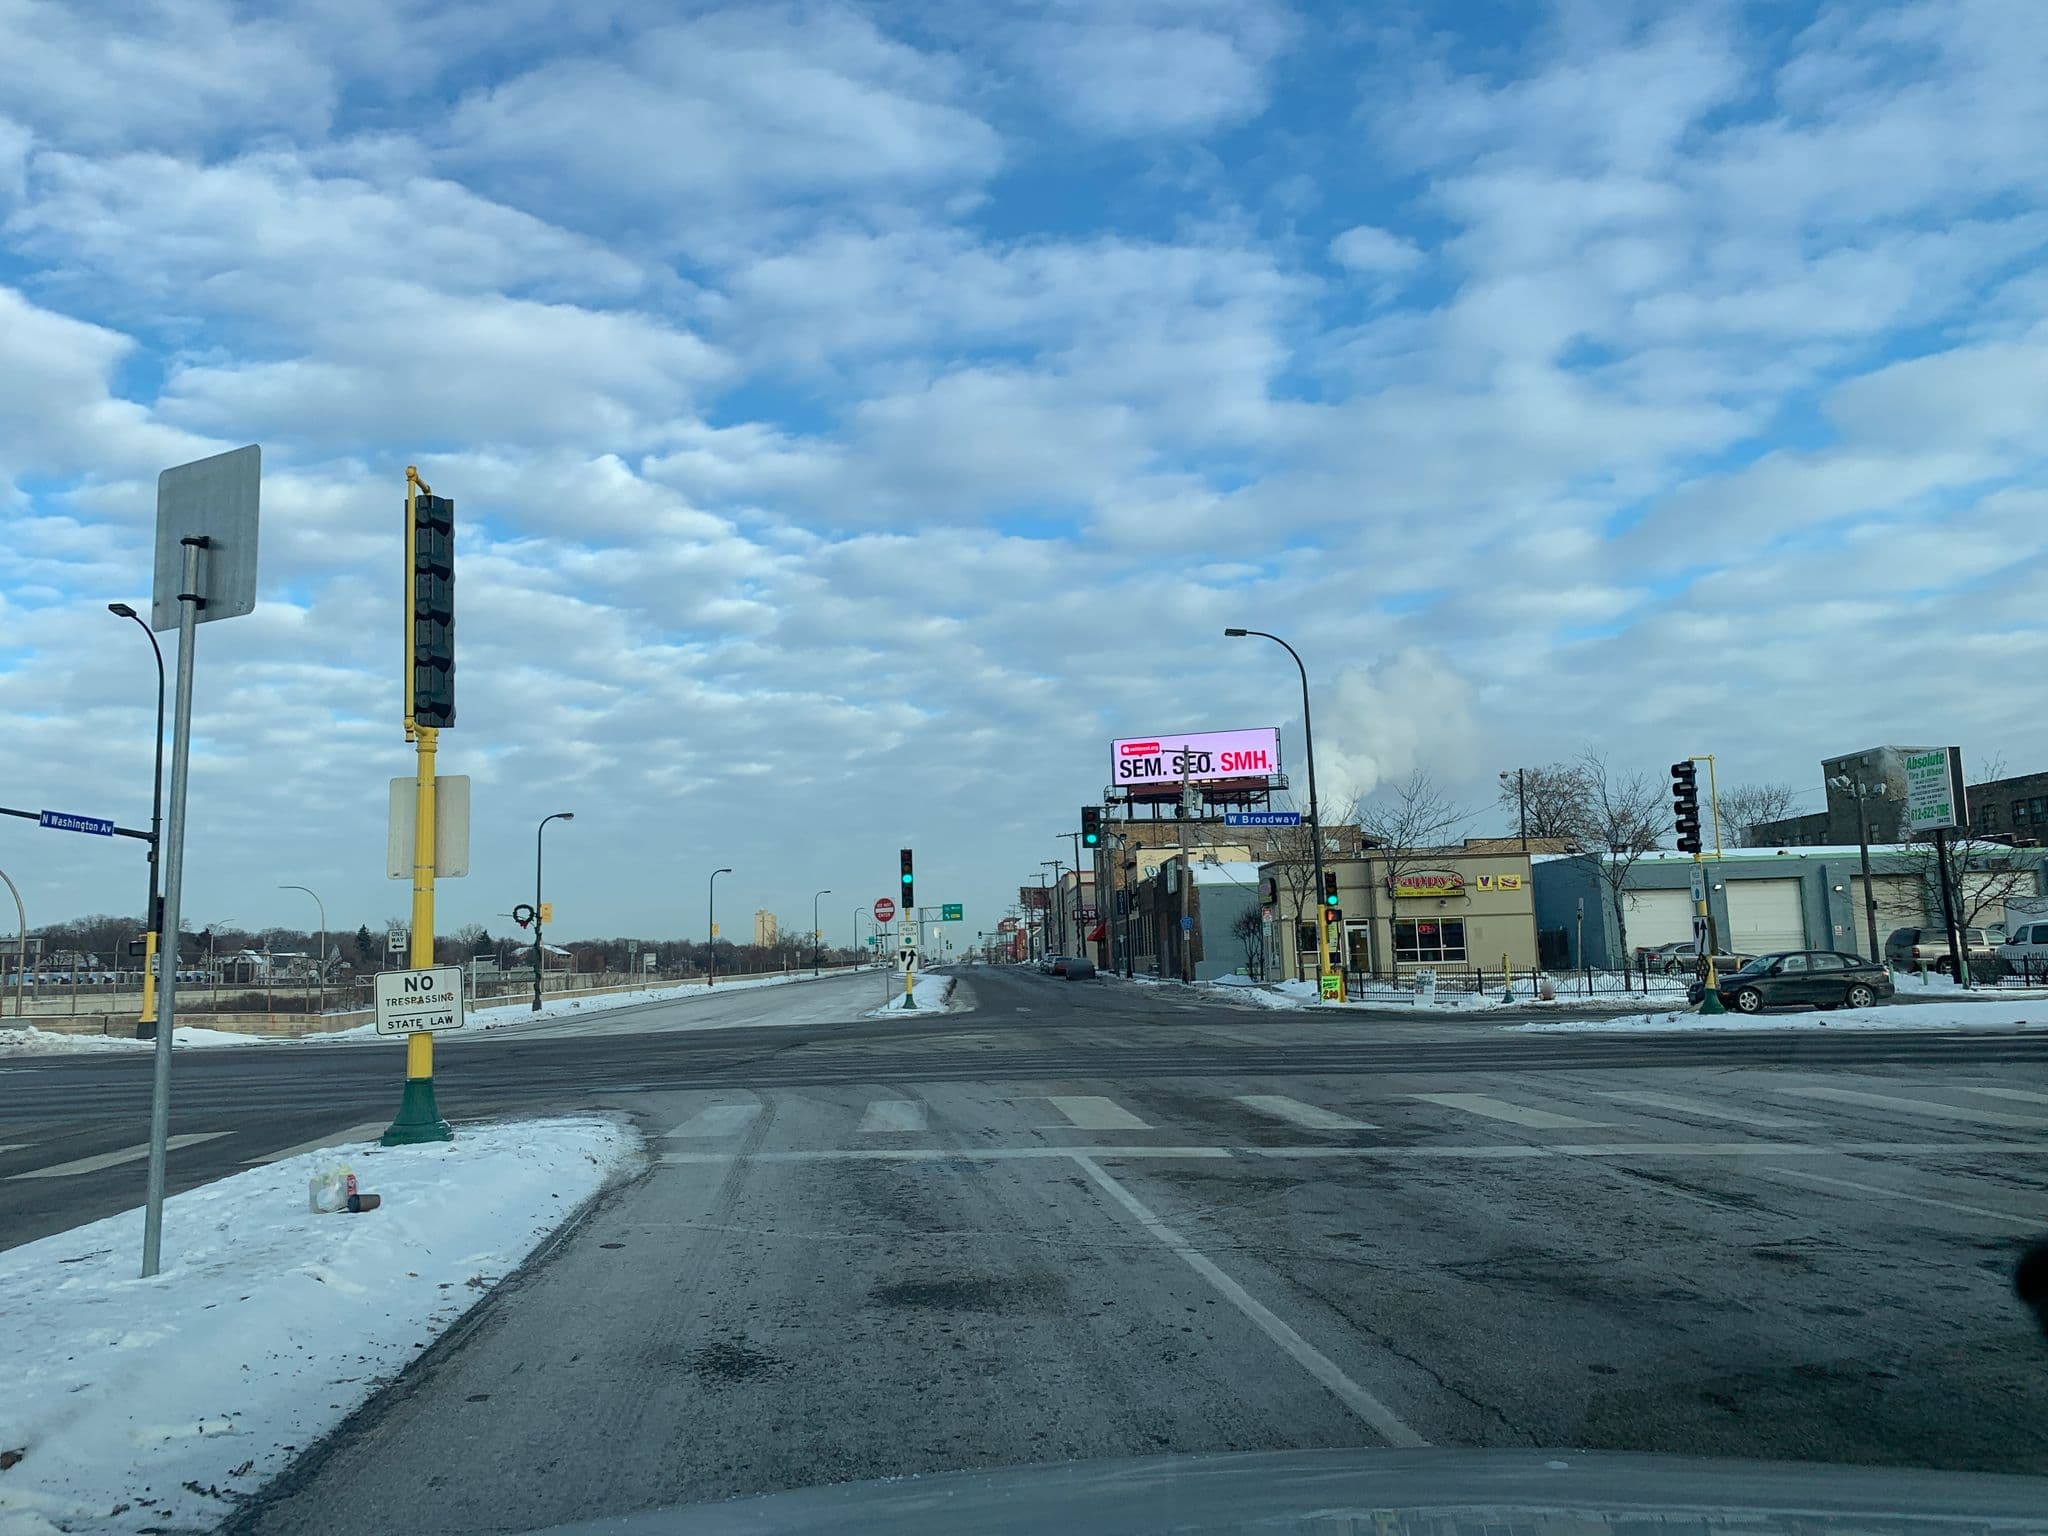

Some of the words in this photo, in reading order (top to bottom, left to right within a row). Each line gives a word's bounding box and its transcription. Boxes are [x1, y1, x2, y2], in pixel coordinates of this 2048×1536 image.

[1120, 758, 1167, 779] SEM.
[1172, 754, 1216, 775] SEO.
[1220, 750, 1273, 772] SMH.
[1906, 752, 1945, 771] Absolute
[1926, 767, 1944, 777] Wheel
[42, 813, 49, 824] N
[51, 815, 98, 832] Washington
[100, 823, 112, 833] Av
[1228, 815, 1237, 824] W
[1241, 814, 1297, 825] Broadway
[404, 975, 434, 993] NO
[385, 992, 454, 1007] TRESPASSING
[388, 1018, 423, 1030] STATE
[430, 1015, 453, 1026] LAW
